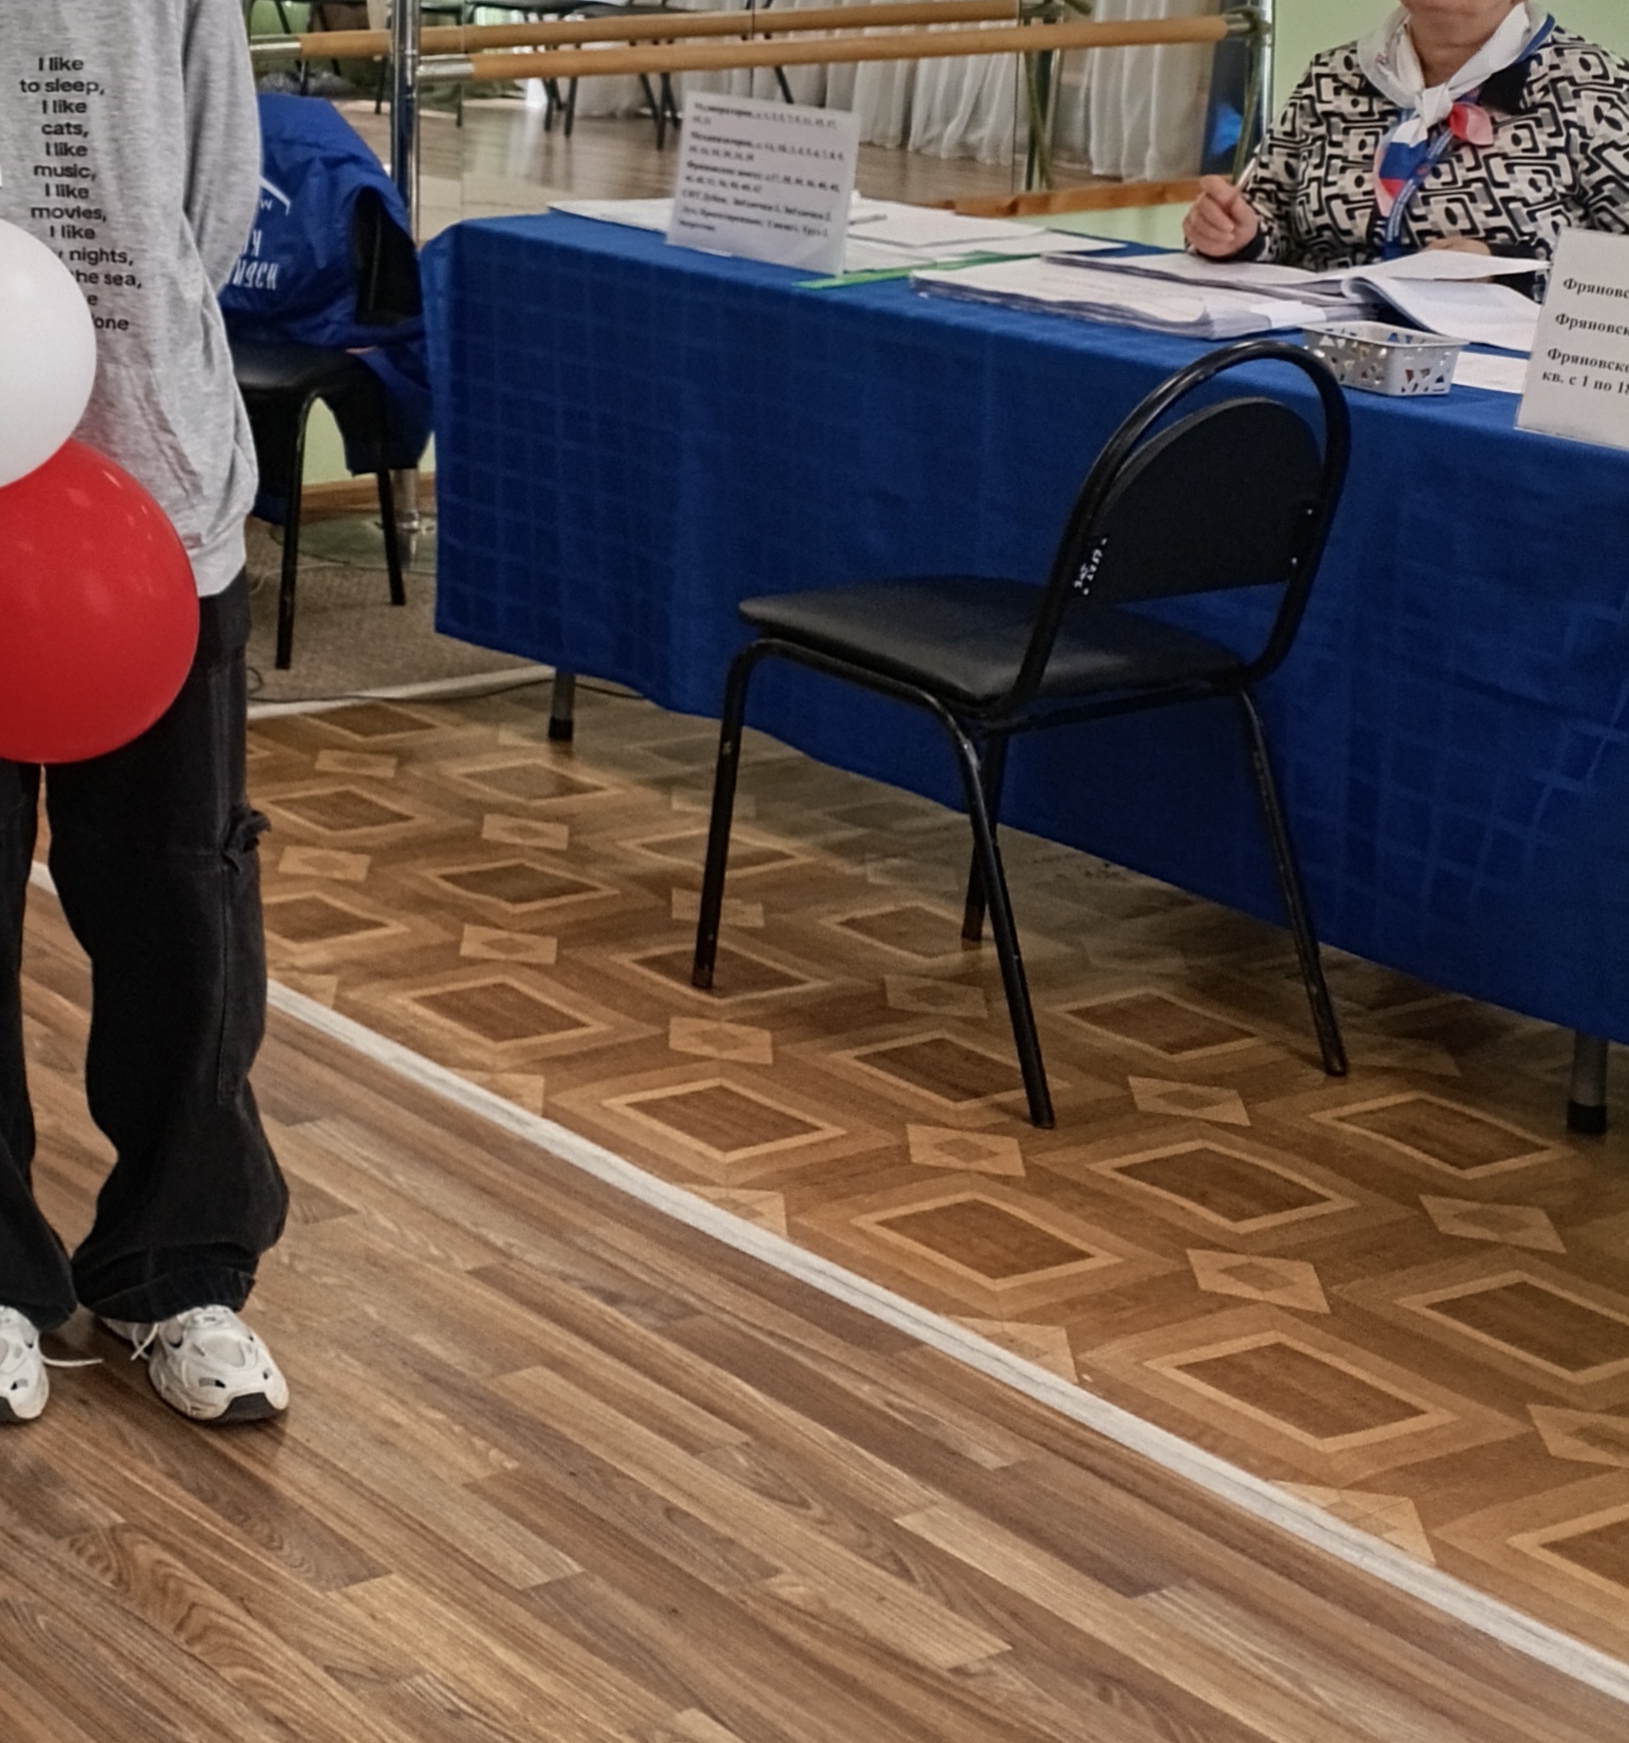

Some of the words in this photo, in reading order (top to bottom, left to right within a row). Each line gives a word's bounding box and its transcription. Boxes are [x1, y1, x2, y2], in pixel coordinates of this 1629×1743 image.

[38, 57, 44, 71] I
[48, 57, 84, 71] like
[20, 79, 40, 93] to
[45, 78, 105, 96] sleep,
[42, 100, 47, 114] I
[52, 100, 87, 113] like
[41, 122, 89, 138] cats,
[45, 142, 51, 156] I
[54, 142, 88, 157] like
[34, 163, 97, 181] music,
[45, 183, 50, 197] I
[55, 183, 90, 198] like
[30, 205, 107, 222] movies,
[49, 225, 55, 237] I
[61, 224, 96, 239] like
[70, 247, 134, 267] nights,
[72, 269, 100, 284] he
[103, 273, 143, 289] sea,
[1542, 371, 1564, 384] кв.
[1569, 375, 1577, 386] с
[1594, 380, 1612, 392] по
